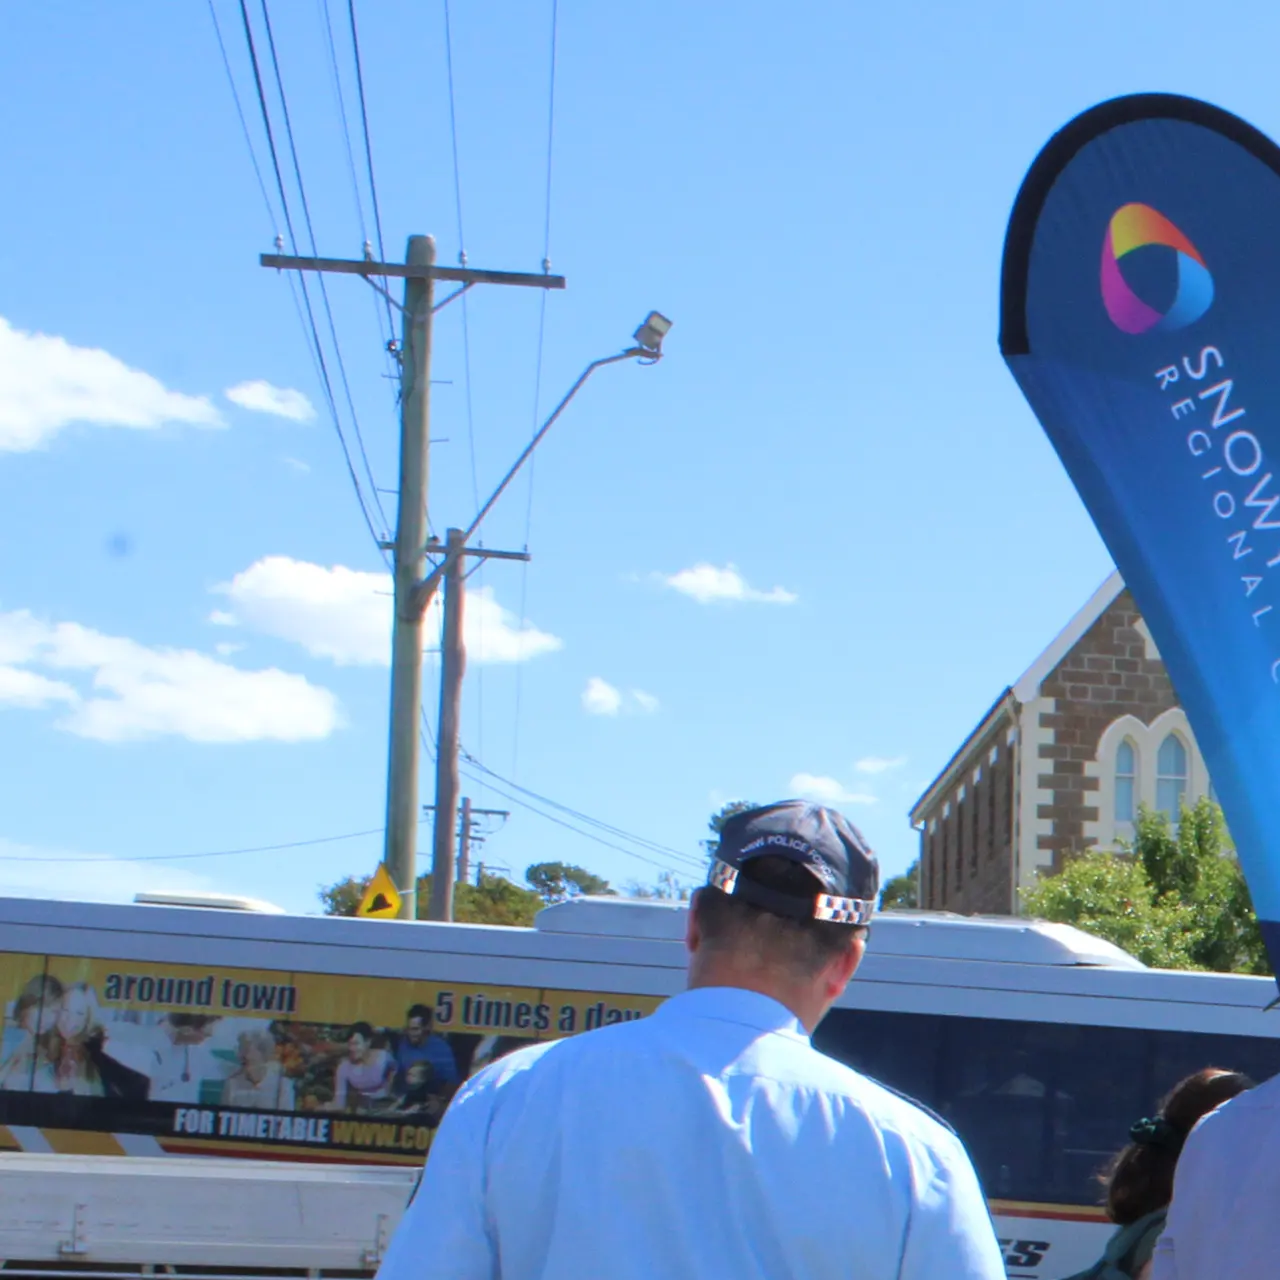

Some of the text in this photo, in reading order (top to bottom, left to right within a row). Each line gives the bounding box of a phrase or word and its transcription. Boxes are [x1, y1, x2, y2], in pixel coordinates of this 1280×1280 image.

[1154, 365, 1273, 627] REGIONAL
[767, 835, 808, 852] POLICE
[105, 973, 297, 1012] around town
[434, 991, 454, 1024] 5
[461, 993, 550, 1030] times
[558, 1005, 576, 1032] a
[173, 1108, 437, 1150] FOR TIMETABLE WWW.CO
